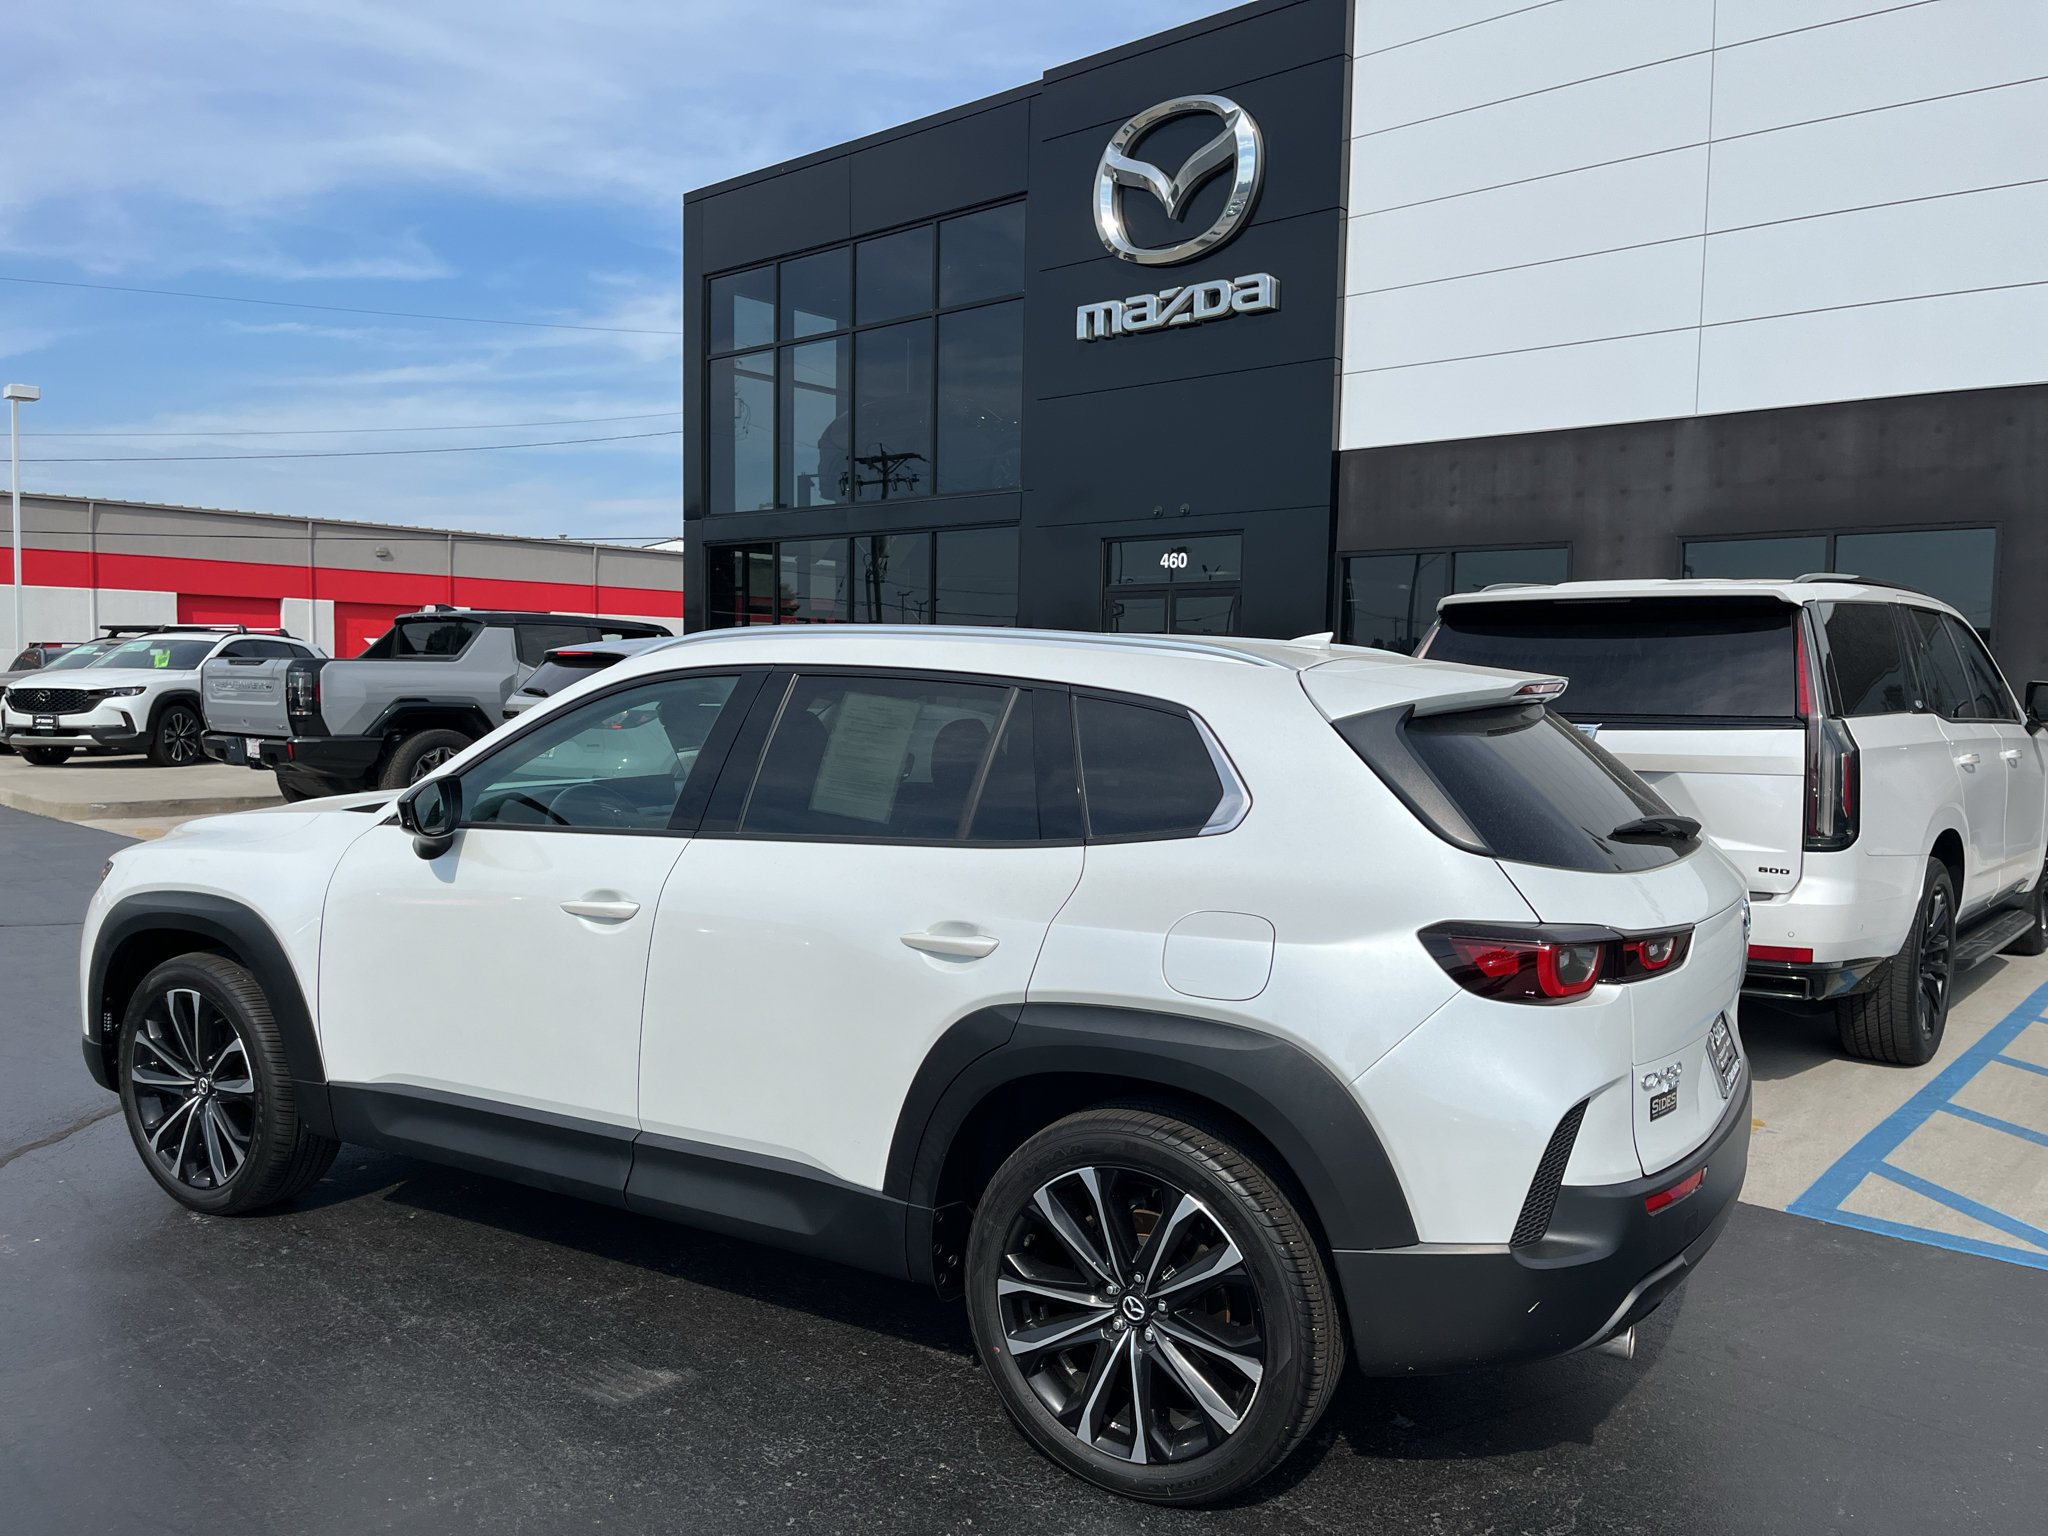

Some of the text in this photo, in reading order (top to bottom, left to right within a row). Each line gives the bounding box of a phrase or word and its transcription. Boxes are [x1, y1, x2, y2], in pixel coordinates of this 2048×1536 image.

[1160, 552, 1188, 569] 460
[1758, 866, 1790, 875] 600
[1651, 1092, 1677, 1114] SIDES
